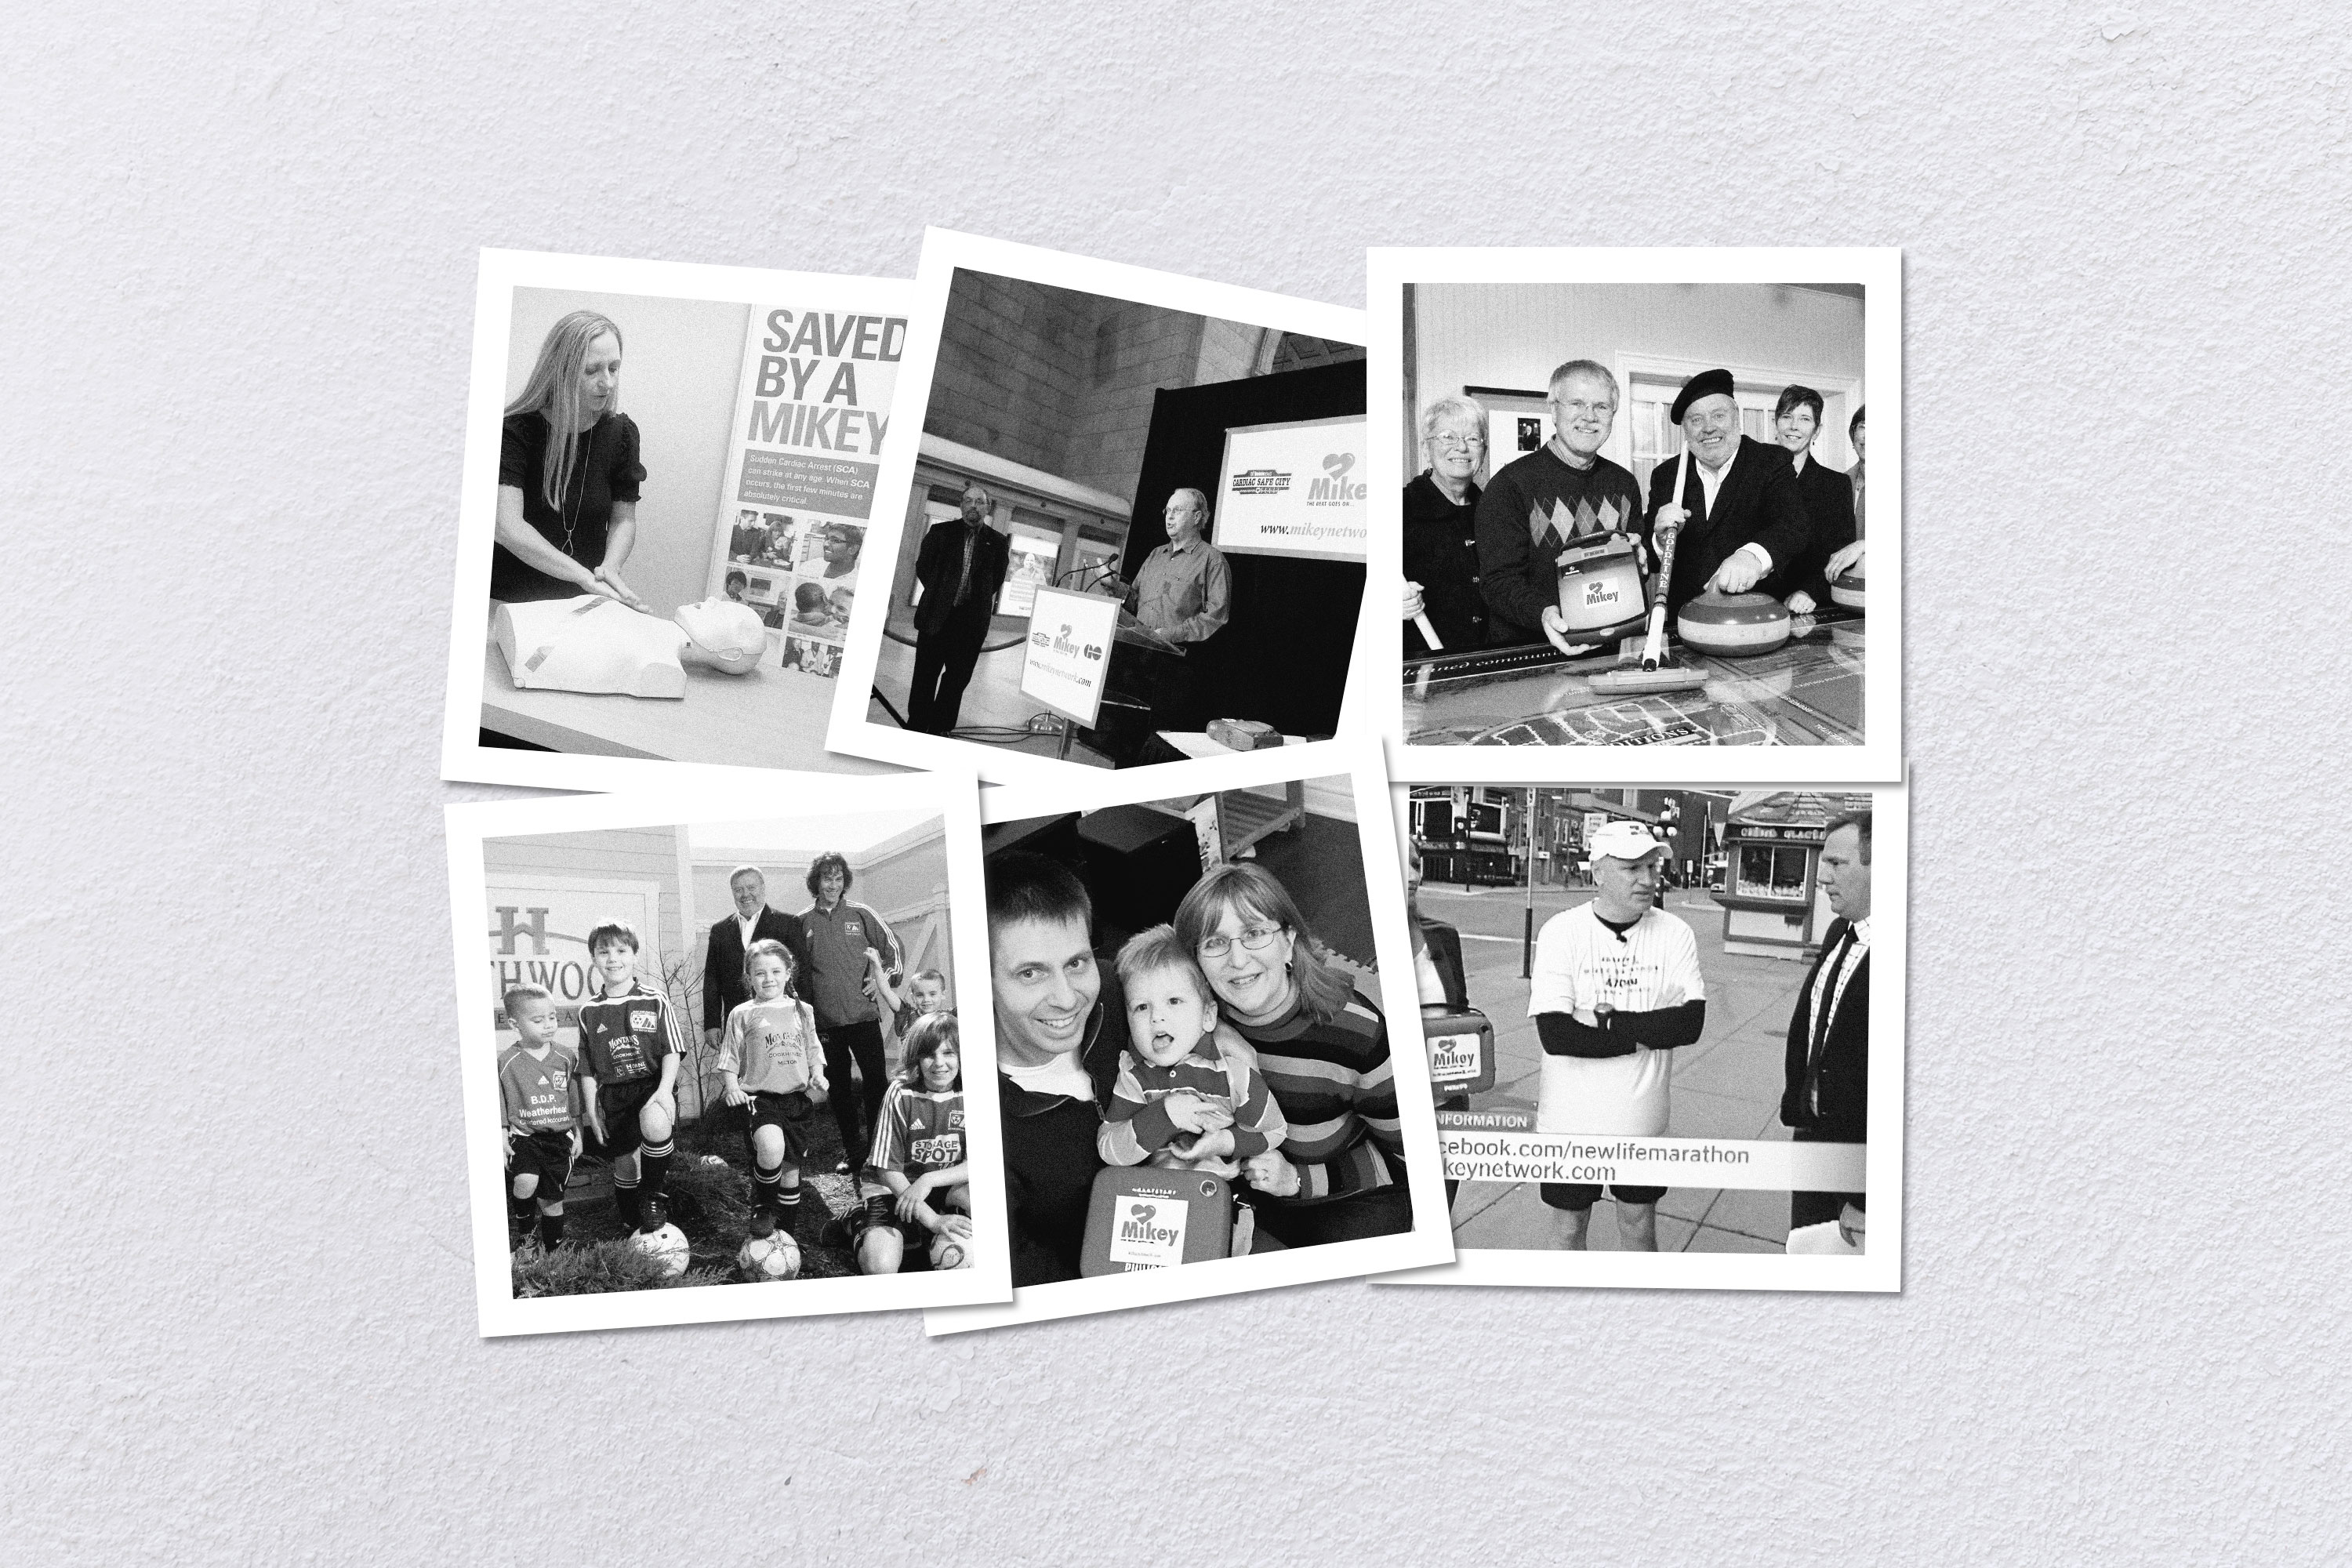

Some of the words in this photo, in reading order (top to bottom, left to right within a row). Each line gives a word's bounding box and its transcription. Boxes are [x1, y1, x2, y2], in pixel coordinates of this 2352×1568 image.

[764, 309, 908, 361] SAVED
[755, 355, 820, 401] BY
[823, 362, 858, 406] A
[747, 400, 890, 456] MIKEY
[750, 455, 776, 464] Sudden
[779, 458, 806, 468] Cardiac
[808, 461, 832, 471] Arrest
[833, 464, 858, 475] (SCA)
[763, 469, 782, 477] strike
[826, 475, 848, 486] When
[850, 478, 870, 488] SCA
[1308, 476, 1367, 500] Mike
[744, 491, 781, 502] absolutely
[782, 495, 808, 505] critical.
[746, 479, 771, 489] occurs,
[787, 483, 802, 492] first
[804, 485, 818, 494] few
[818, 488, 848, 499] minutes
[1261, 522, 1367, 540] www.mikeynetwo
[1659, 533, 1675, 588] GOLDLINE
[1586, 591, 1618, 605] Mikey
[1054, 636, 1080, 659] Mikey
[1475, 652, 1563, 666] communi
[1434, 1051, 1474, 1066] Mikey
[531, 1094, 557, 1105] B.D.P.
[914, 1148, 958, 1162] SPOT
[1121, 1221, 1179, 1247] Mikey
